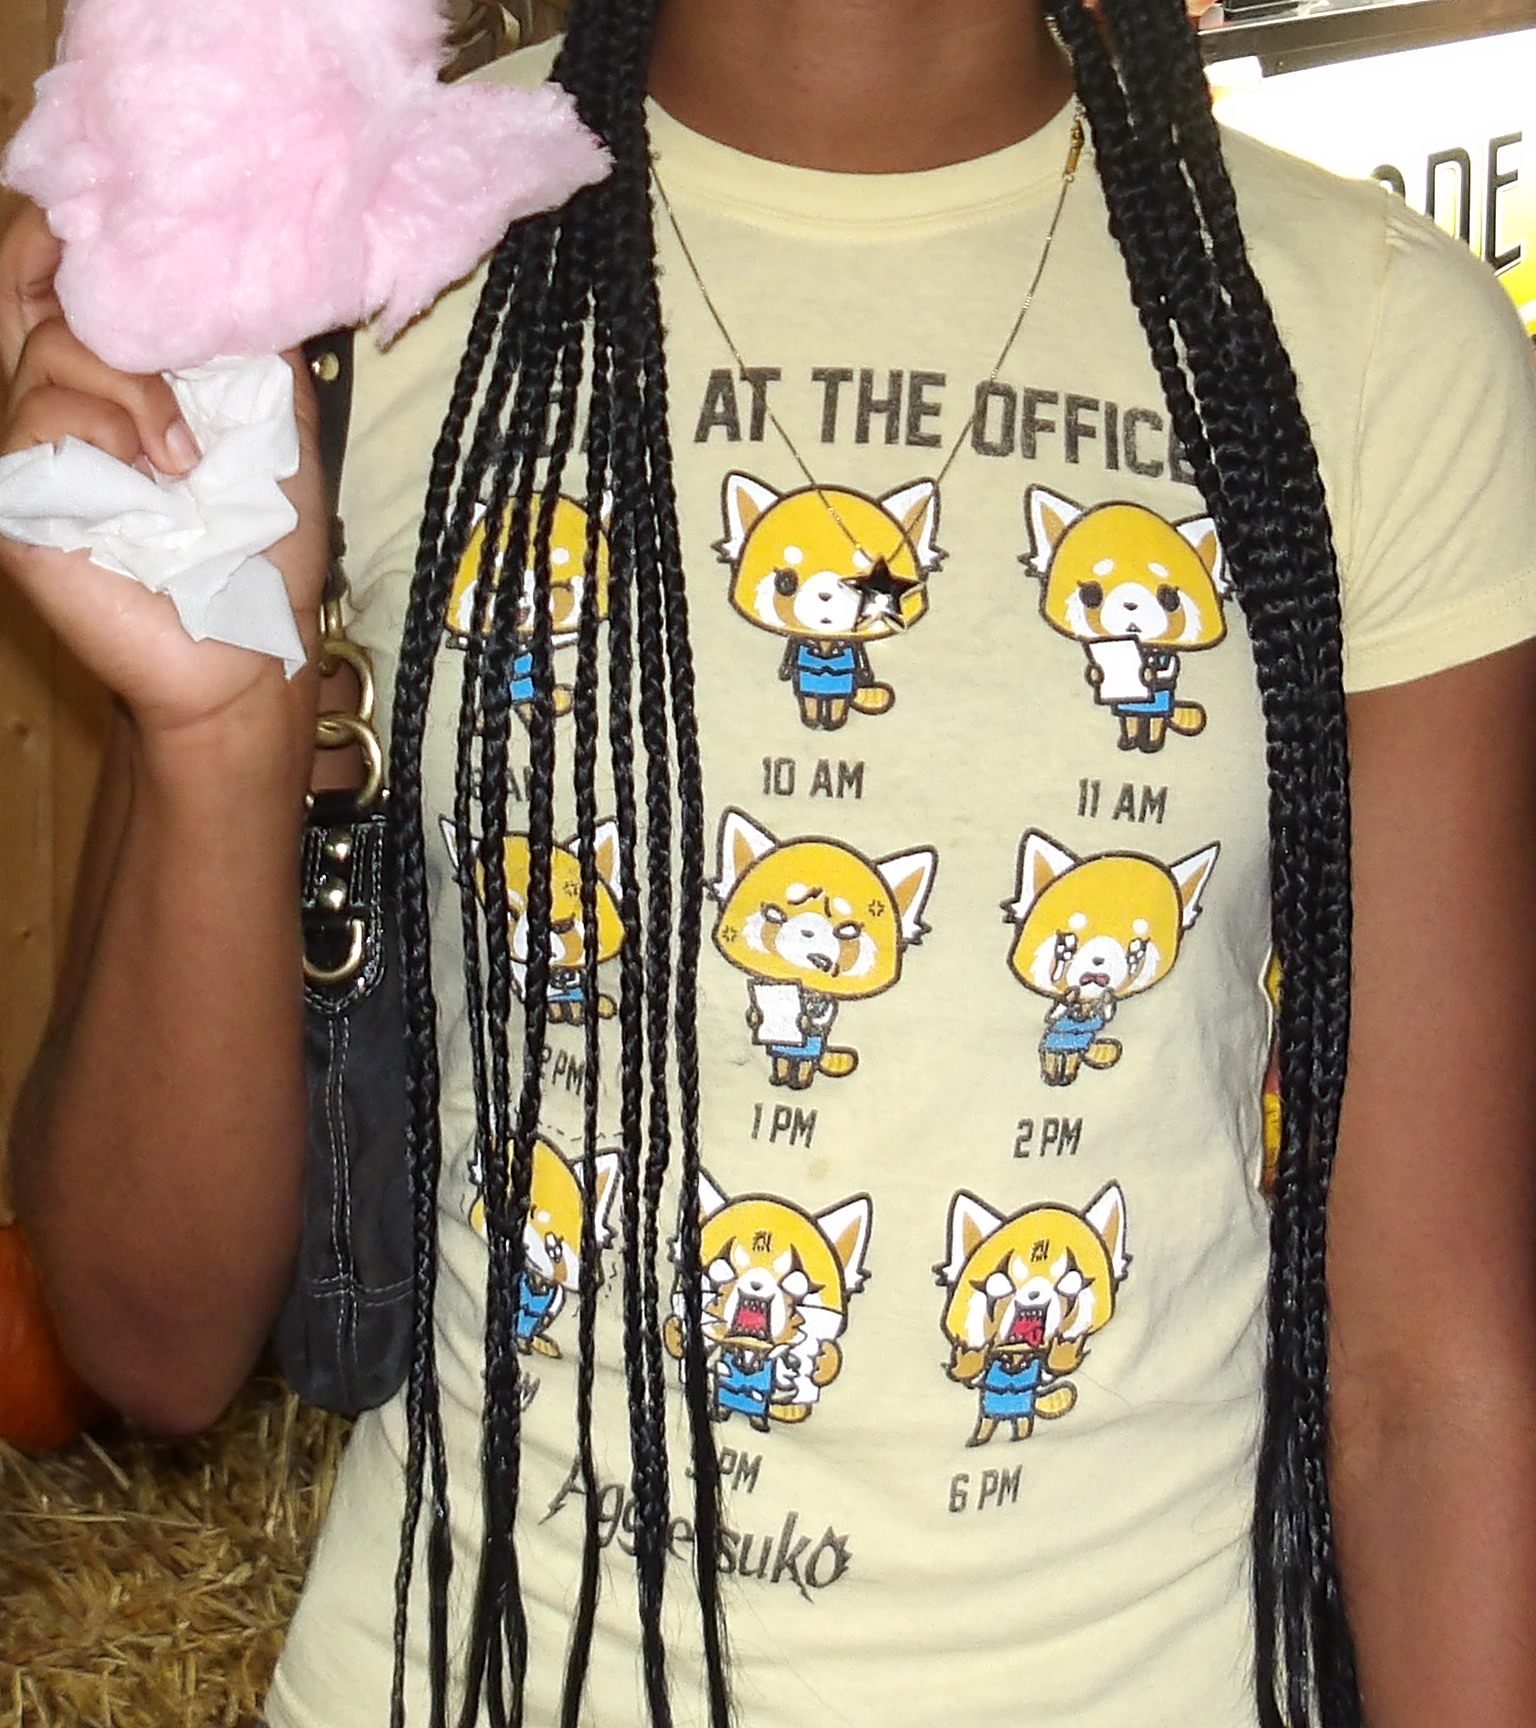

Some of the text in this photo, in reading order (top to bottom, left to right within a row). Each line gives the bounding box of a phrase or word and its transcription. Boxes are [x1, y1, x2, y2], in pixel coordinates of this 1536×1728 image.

[693, 366, 783, 443] AT
[810, 366, 948, 449] THE
[761, 755, 866, 800] 10 AM
[1076, 776, 1169, 825] 11 AM
[750, 1101, 819, 1150] 1 PM
[1012, 1116, 1085, 1160] 2 PM
[718, 1444, 765, 1495] PM
[947, 1463, 1024, 1513] 6 PM
[537, 1450, 856, 1606] Aggesuko
